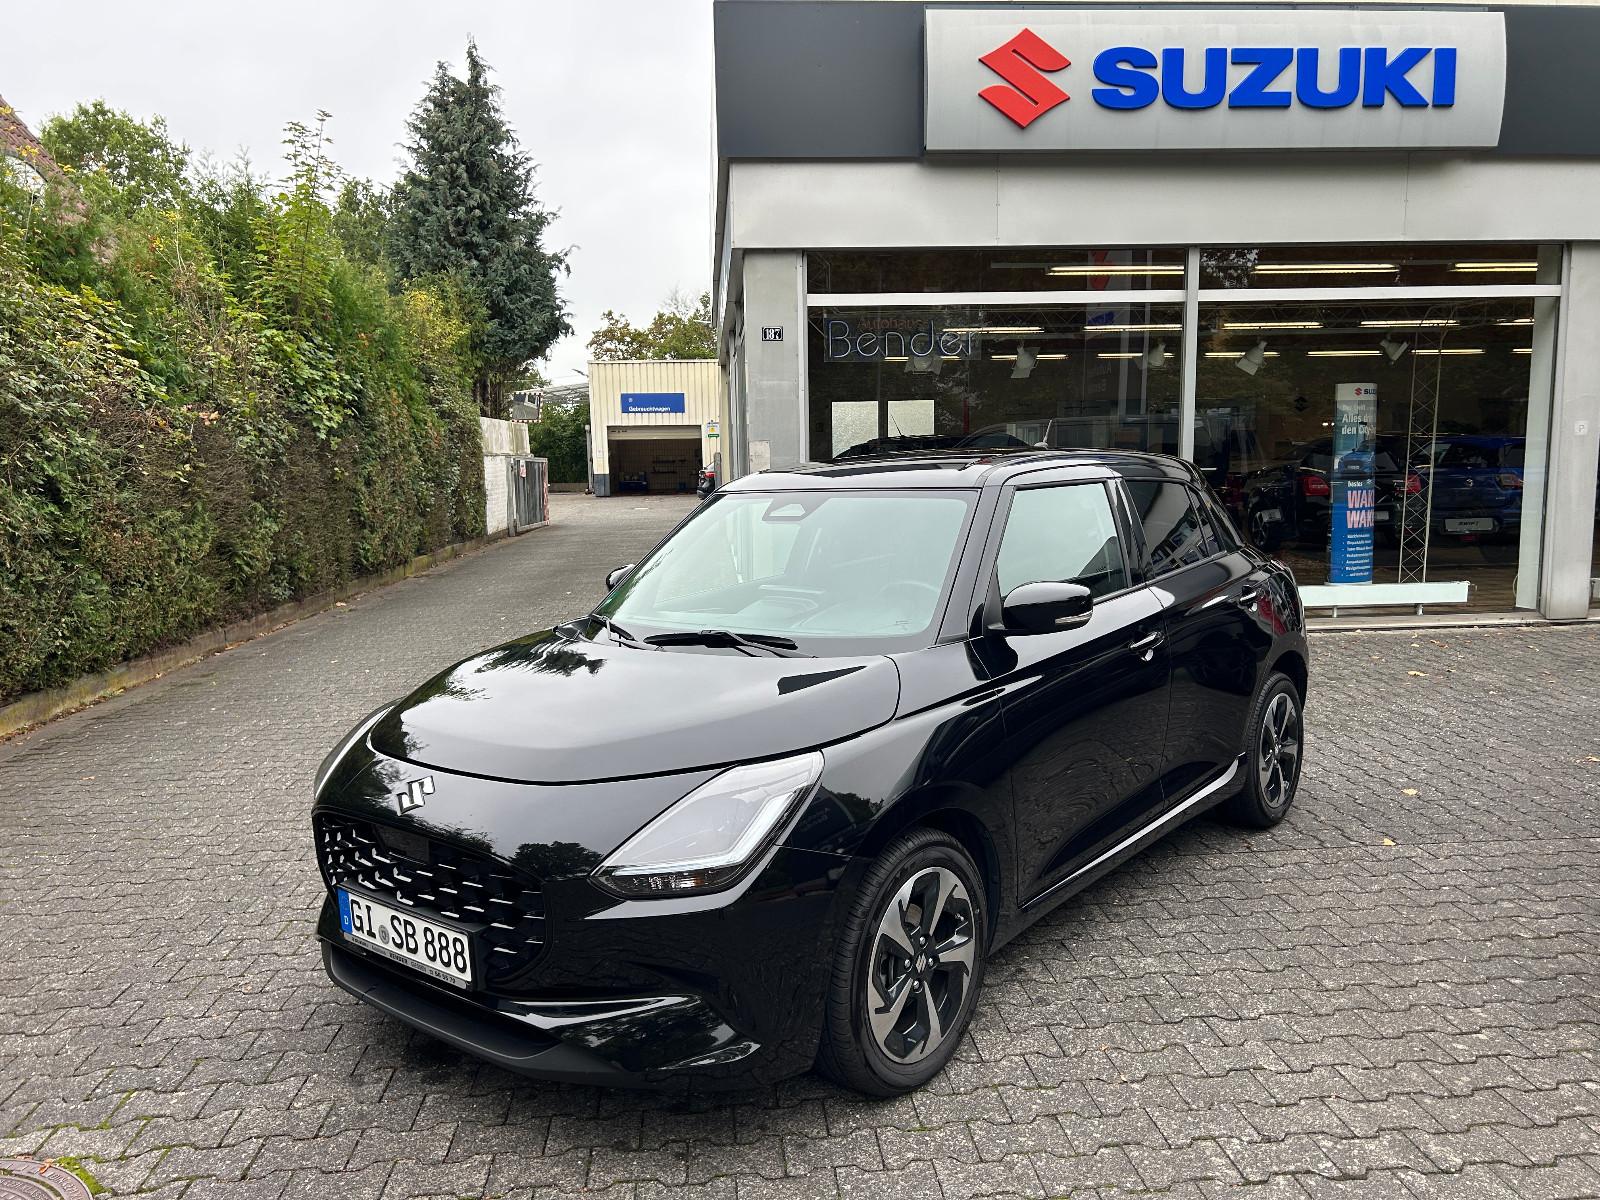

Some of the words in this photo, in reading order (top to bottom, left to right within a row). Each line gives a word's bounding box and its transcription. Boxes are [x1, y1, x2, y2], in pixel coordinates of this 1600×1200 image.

[1091, 46, 1457, 109] SUZUKI
[764, 328, 781, 340] 187
[829, 320, 978, 358] Bender
[1341, 424, 1357, 435] den
[1342, 413, 1362, 423] Alles
[351, 898, 377, 940] GI
[390, 914, 419, 955] SB
[423, 926, 468, 974] 888
